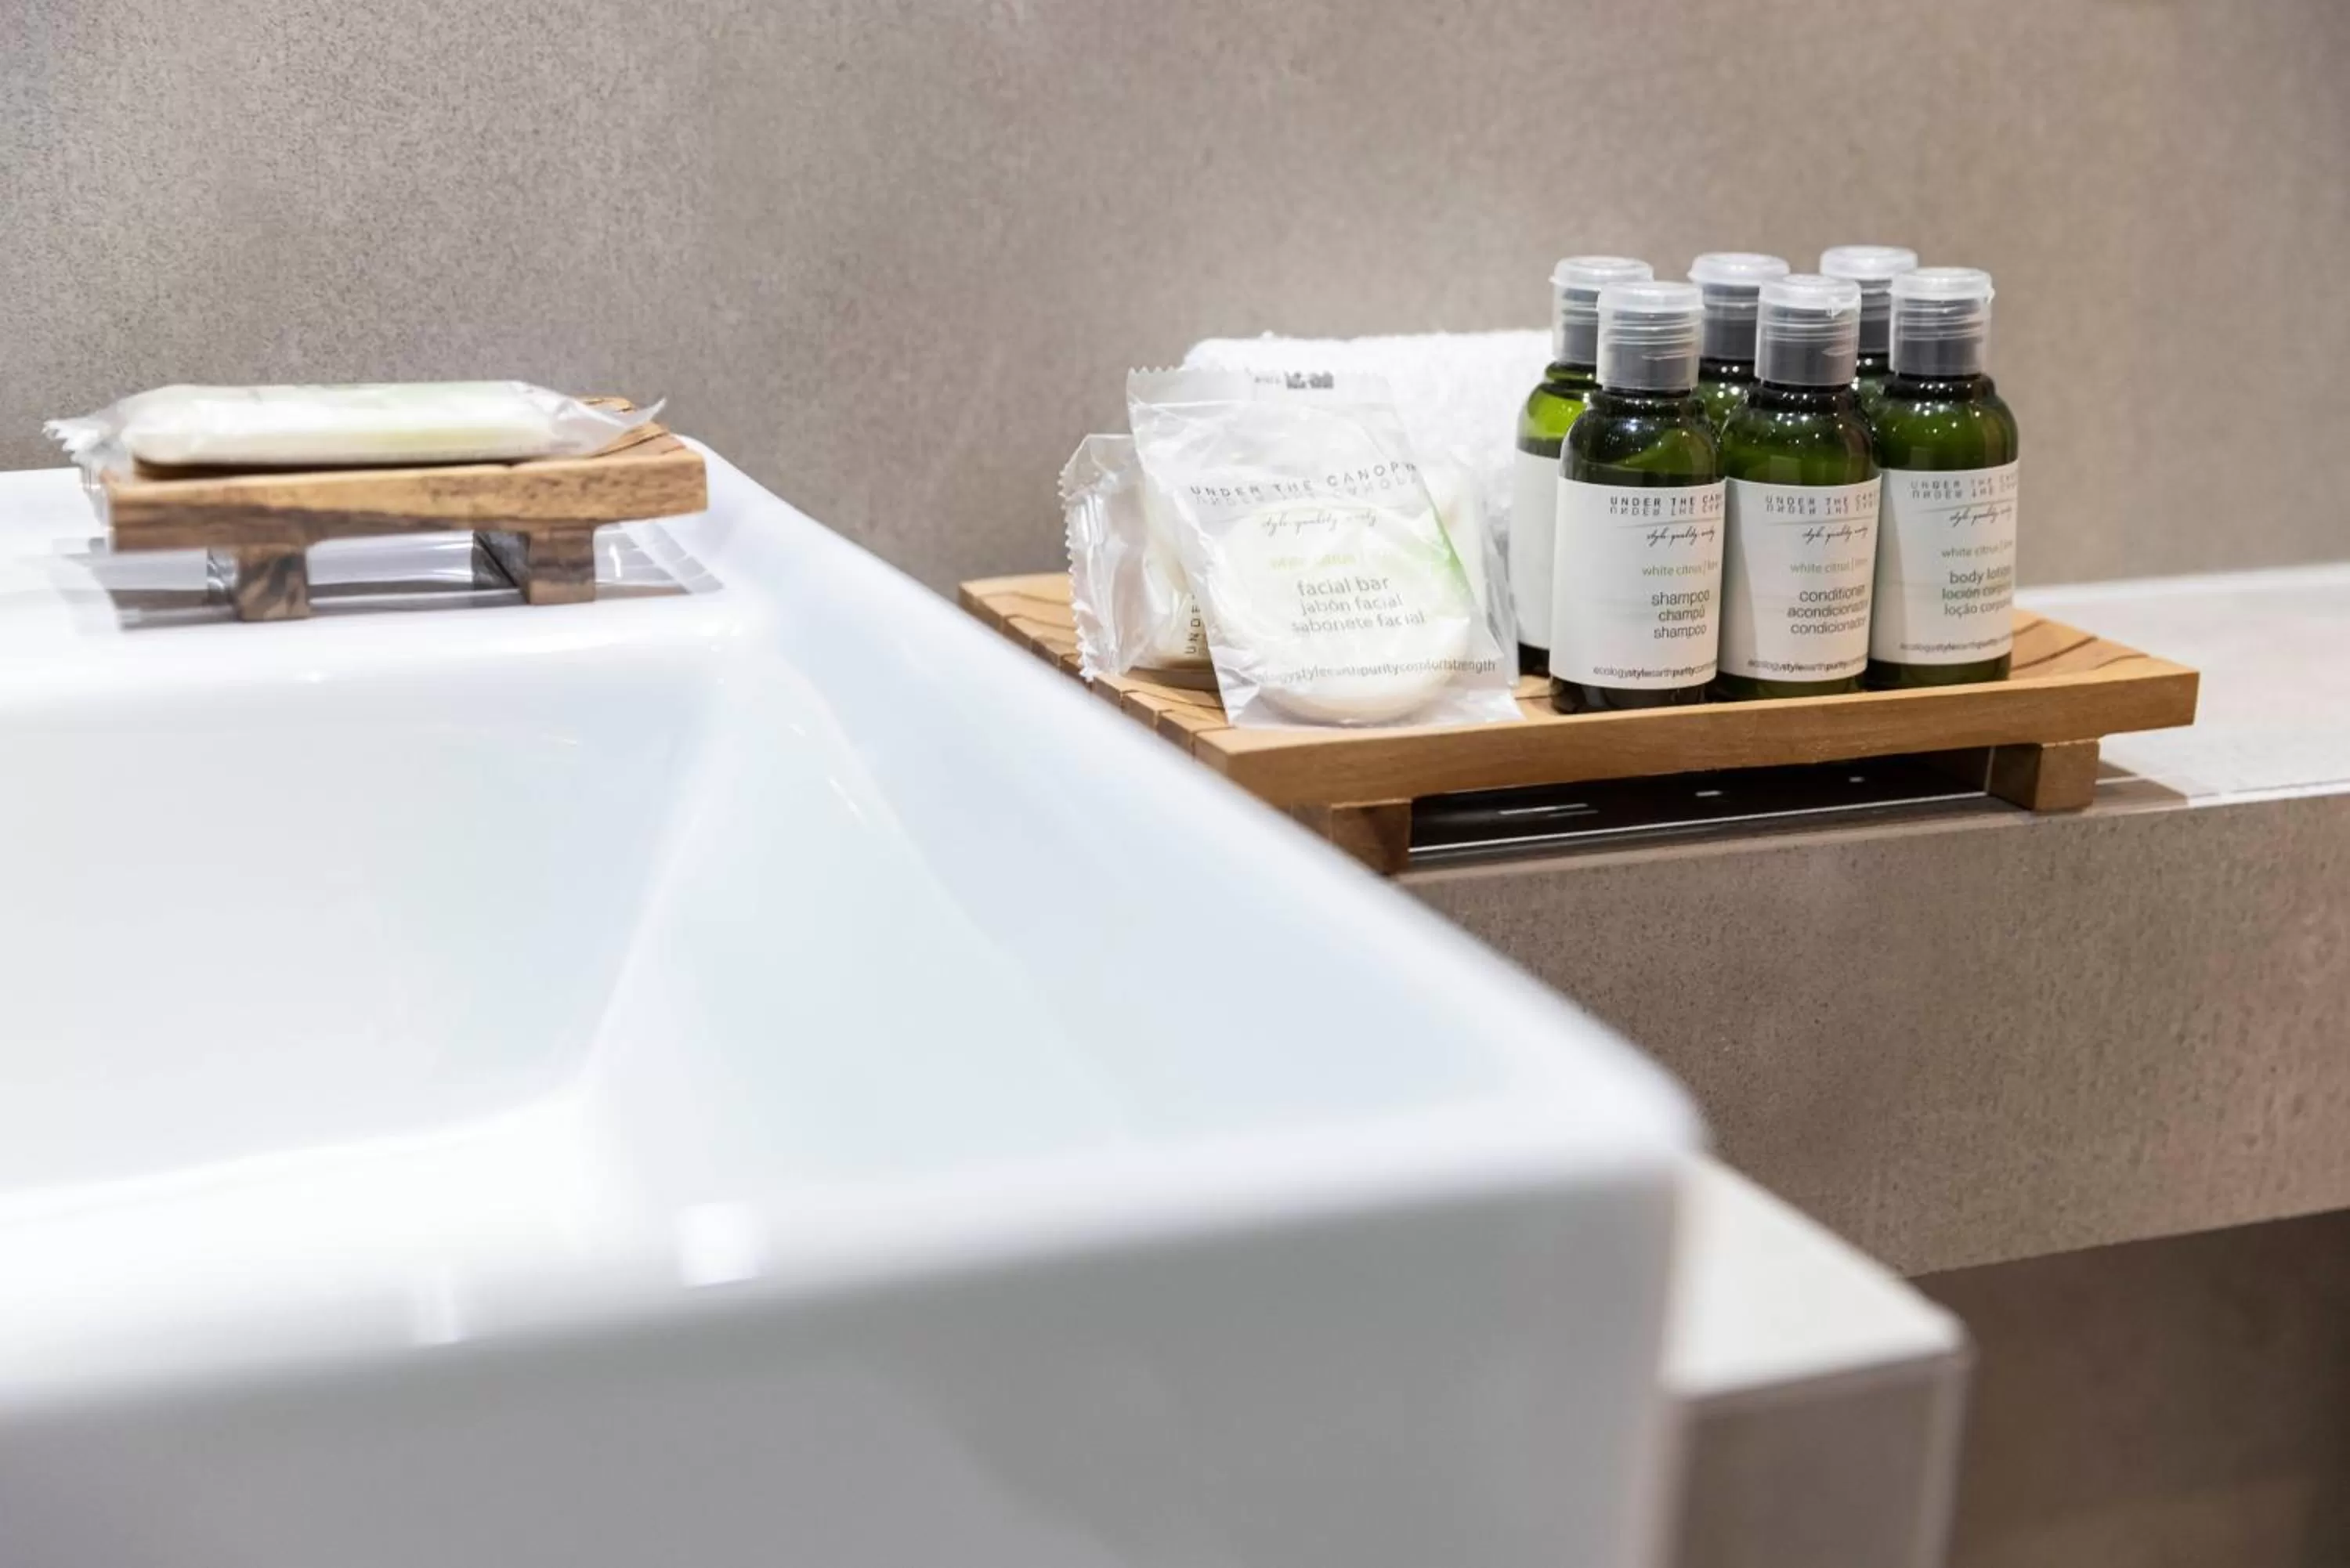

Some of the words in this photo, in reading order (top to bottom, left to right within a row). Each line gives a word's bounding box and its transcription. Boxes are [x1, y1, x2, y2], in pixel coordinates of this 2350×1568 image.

[1190, 484, 1261, 497] UNDER
[1611, 497, 1661, 506] UNDER
[1671, 496, 1696, 505] THE
[1766, 496, 1815, 505] UNDER
[1825, 497, 1849, 505] THE
[1642, 564, 1675, 576] white
[1791, 562, 1823, 573] white
[1950, 569, 1983, 584] body
[1297, 578, 1351, 597] facial
[1355, 576, 1390, 592] bar
[1354, 592, 1405, 612] facial
[1651, 589, 1710, 607] shampoo
[1376, 609, 1426, 627] facial
[1658, 604, 1705, 623] champú
[1654, 624, 1707, 640] shampoo
